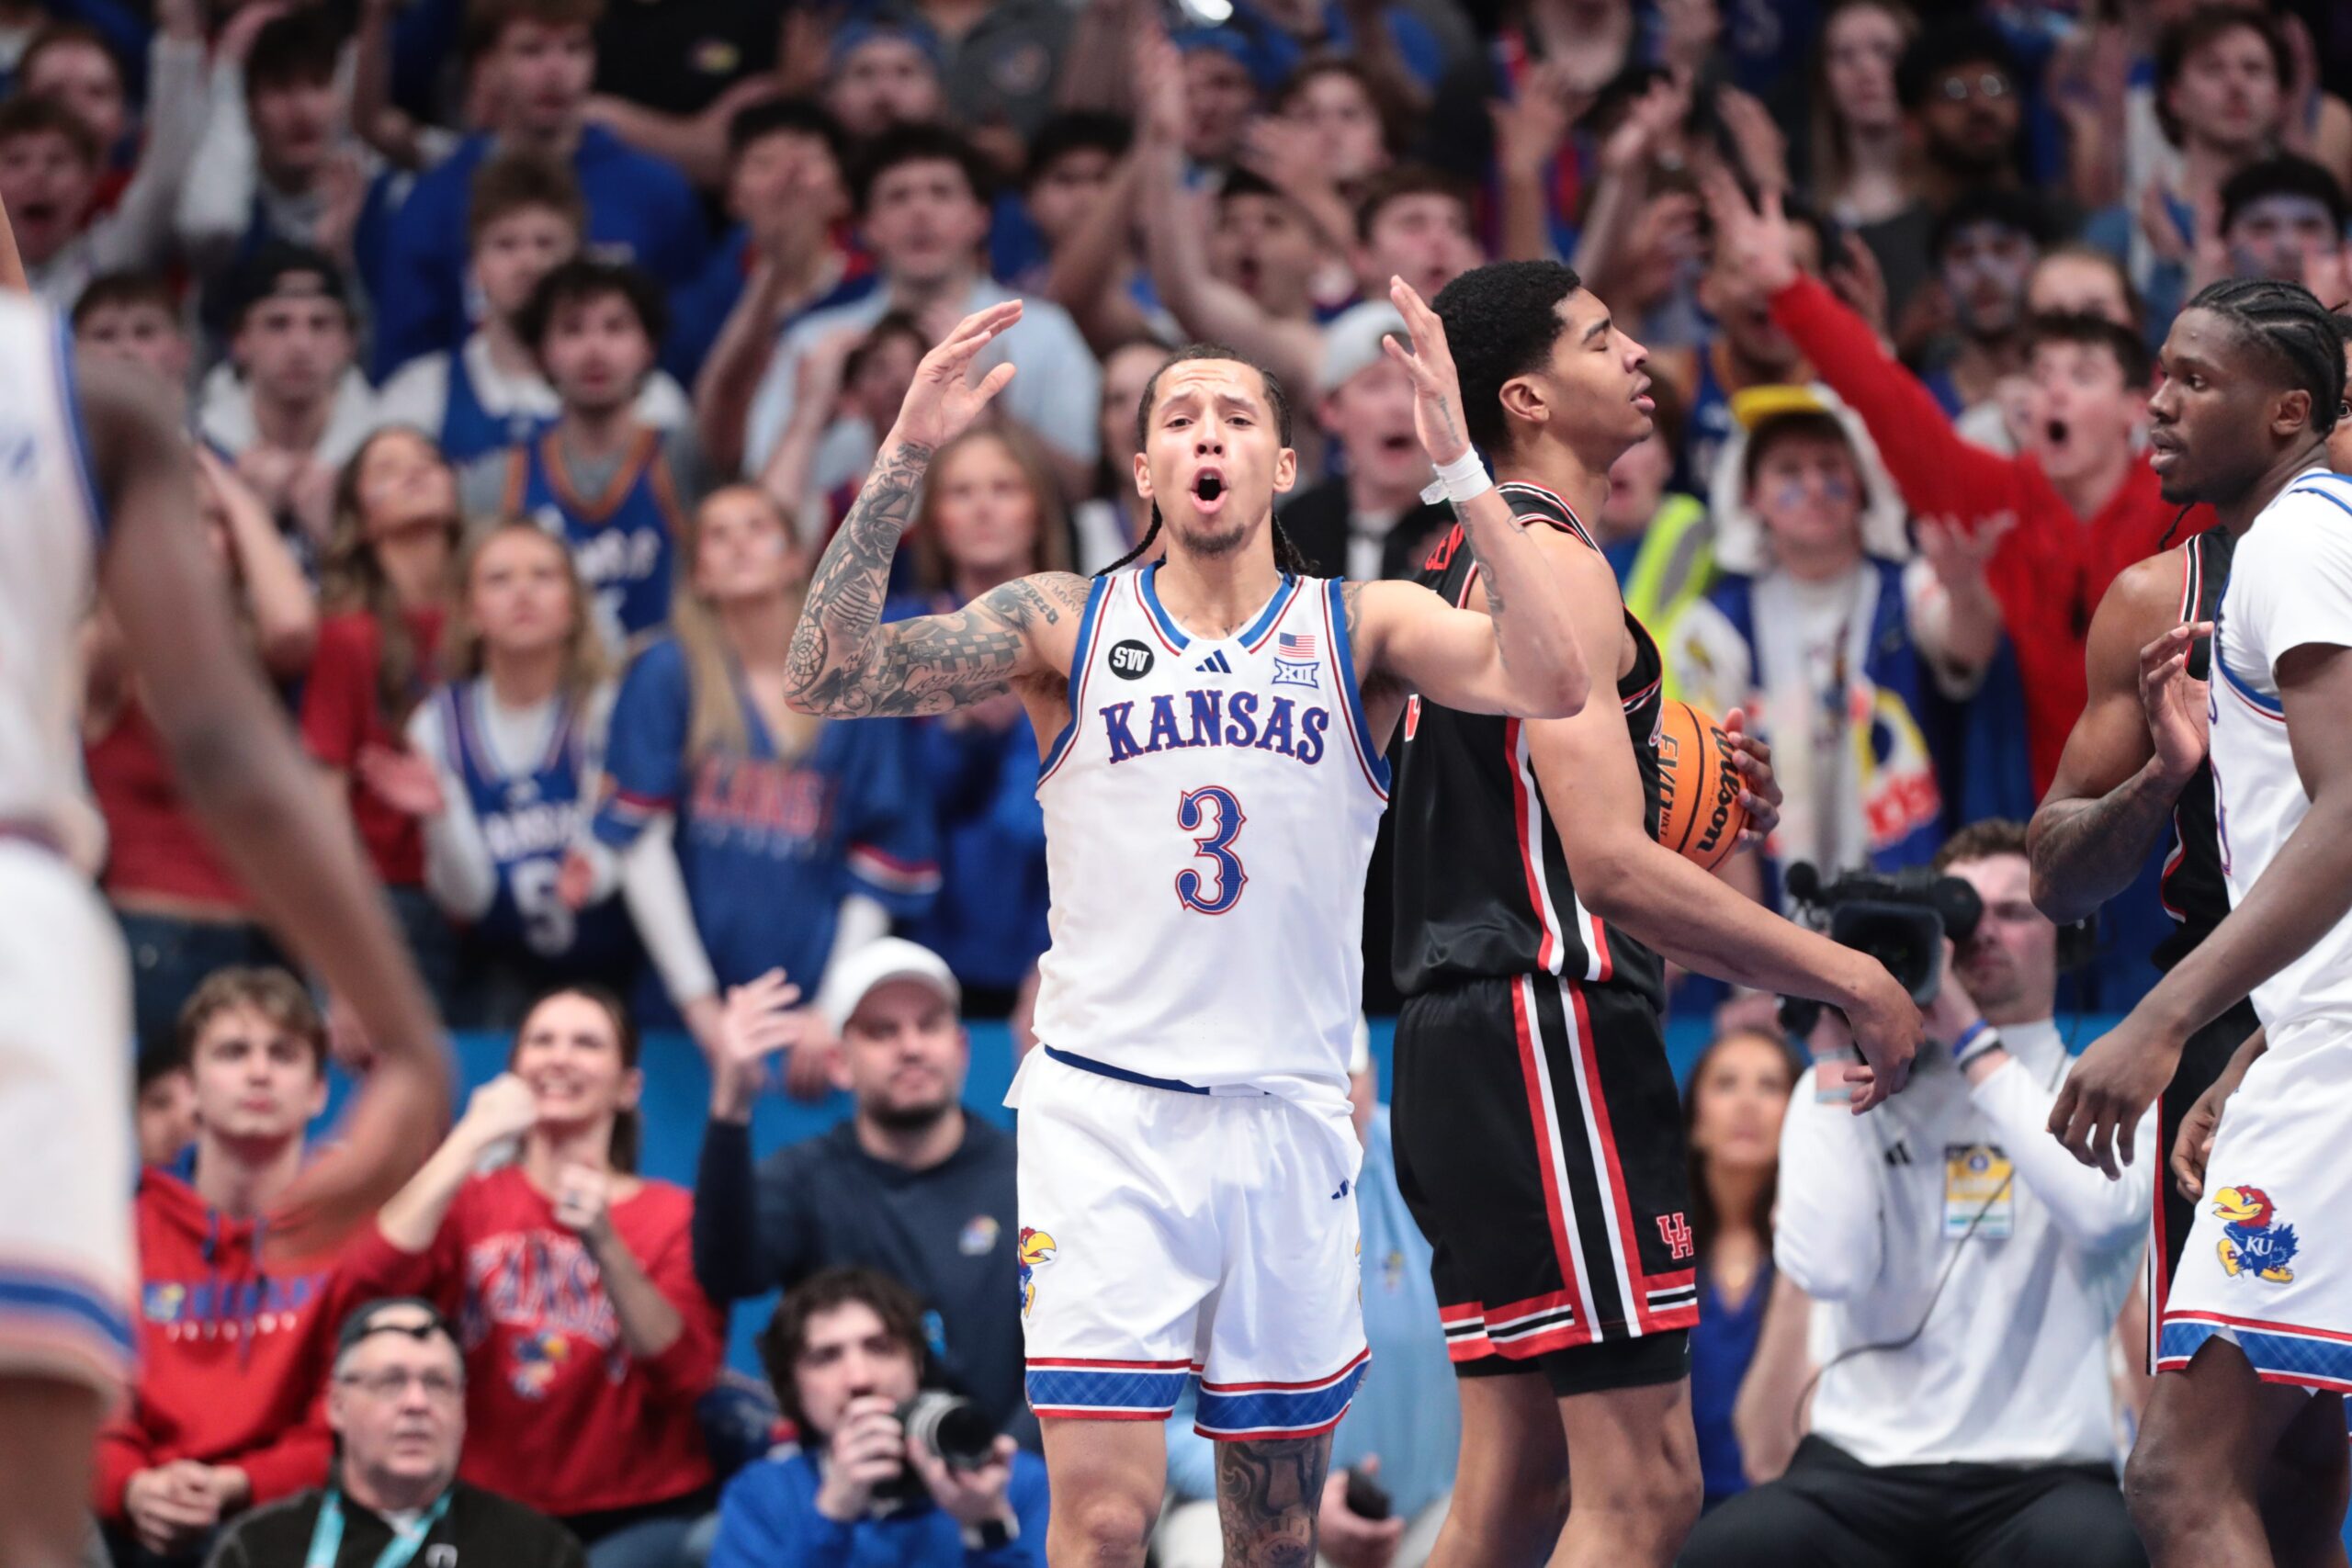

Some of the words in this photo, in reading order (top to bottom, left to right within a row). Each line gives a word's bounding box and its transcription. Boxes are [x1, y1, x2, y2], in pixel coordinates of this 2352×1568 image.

[1112, 646, 1150, 672] SW
[1272, 657, 1321, 689] XII
[1099, 689, 1330, 766] KANSAS
[1174, 784, 1250, 916] 3
[1656, 1212, 1694, 1259] UH
[2245, 1235, 2275, 1257] KU
